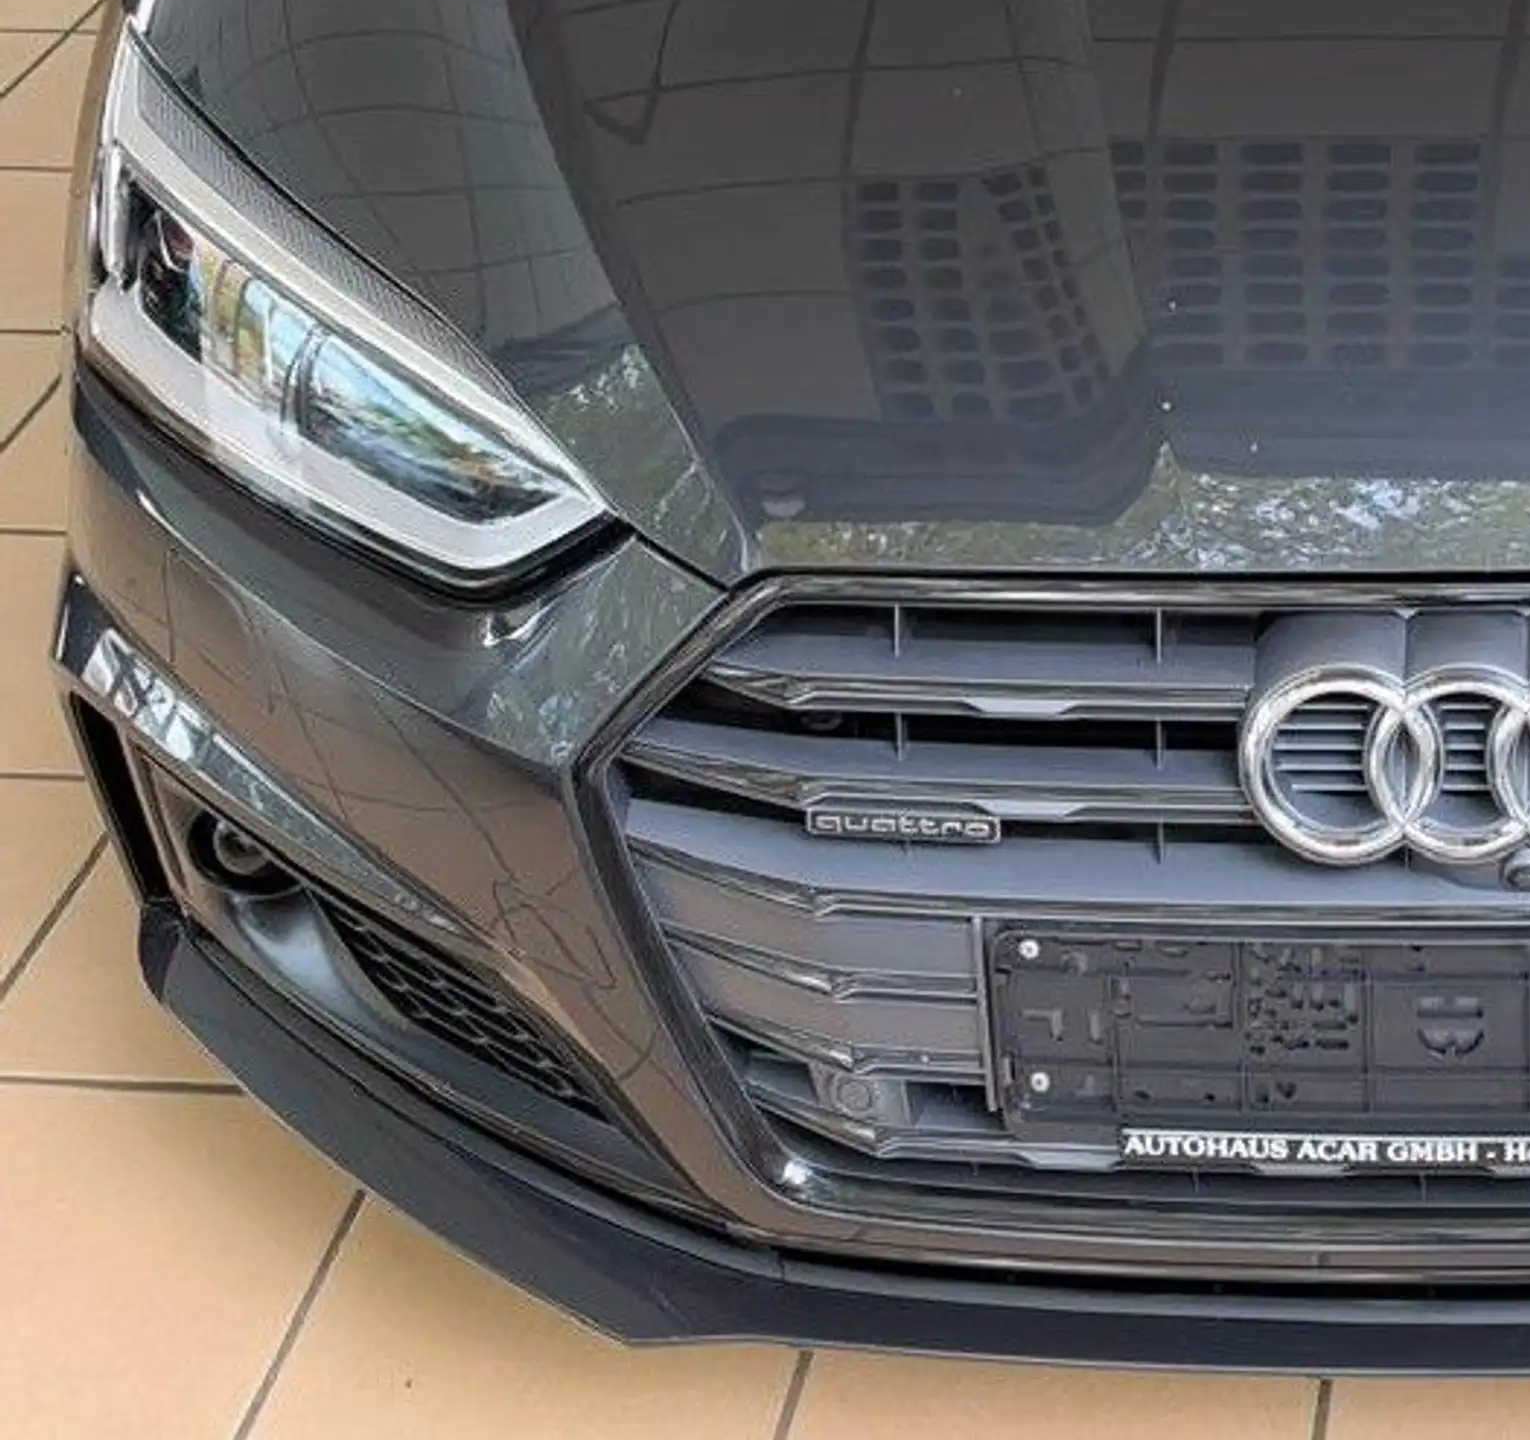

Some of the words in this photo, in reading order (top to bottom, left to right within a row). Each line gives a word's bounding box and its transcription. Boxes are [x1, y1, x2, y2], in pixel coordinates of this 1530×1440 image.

[815, 813, 990, 838] quattro
[1124, 1133, 1288, 1159] AUTOHAUS
[1297, 1139, 1378, 1162] ACAR
[1386, 1141, 1479, 1162] GMBH
